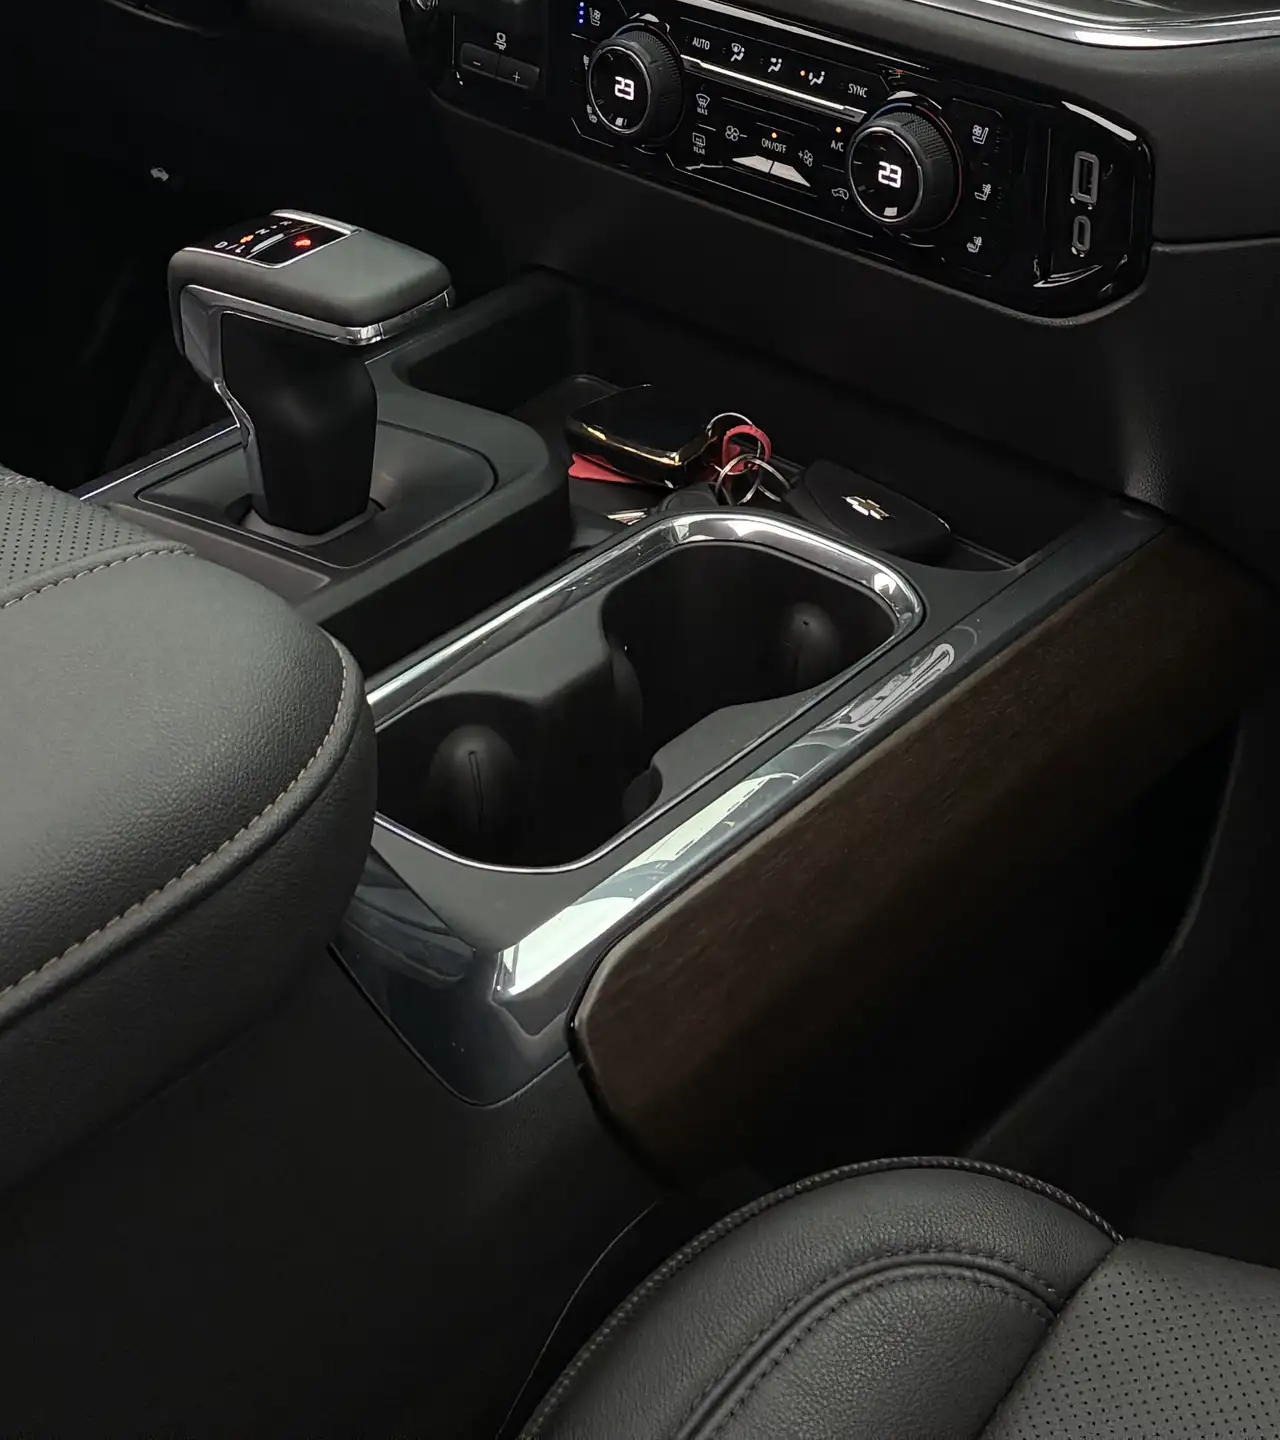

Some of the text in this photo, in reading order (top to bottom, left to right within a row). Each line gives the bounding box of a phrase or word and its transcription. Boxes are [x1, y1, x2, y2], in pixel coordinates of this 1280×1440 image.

[692, 36, 711, 51] AUTO
[614, 75, 635, 101] 23
[847, 82, 869, 99] SYNC
[761, 137, 787, 154] ON/OFF
[830, 140, 844, 153] A/C
[878, 160, 902, 189] 23
